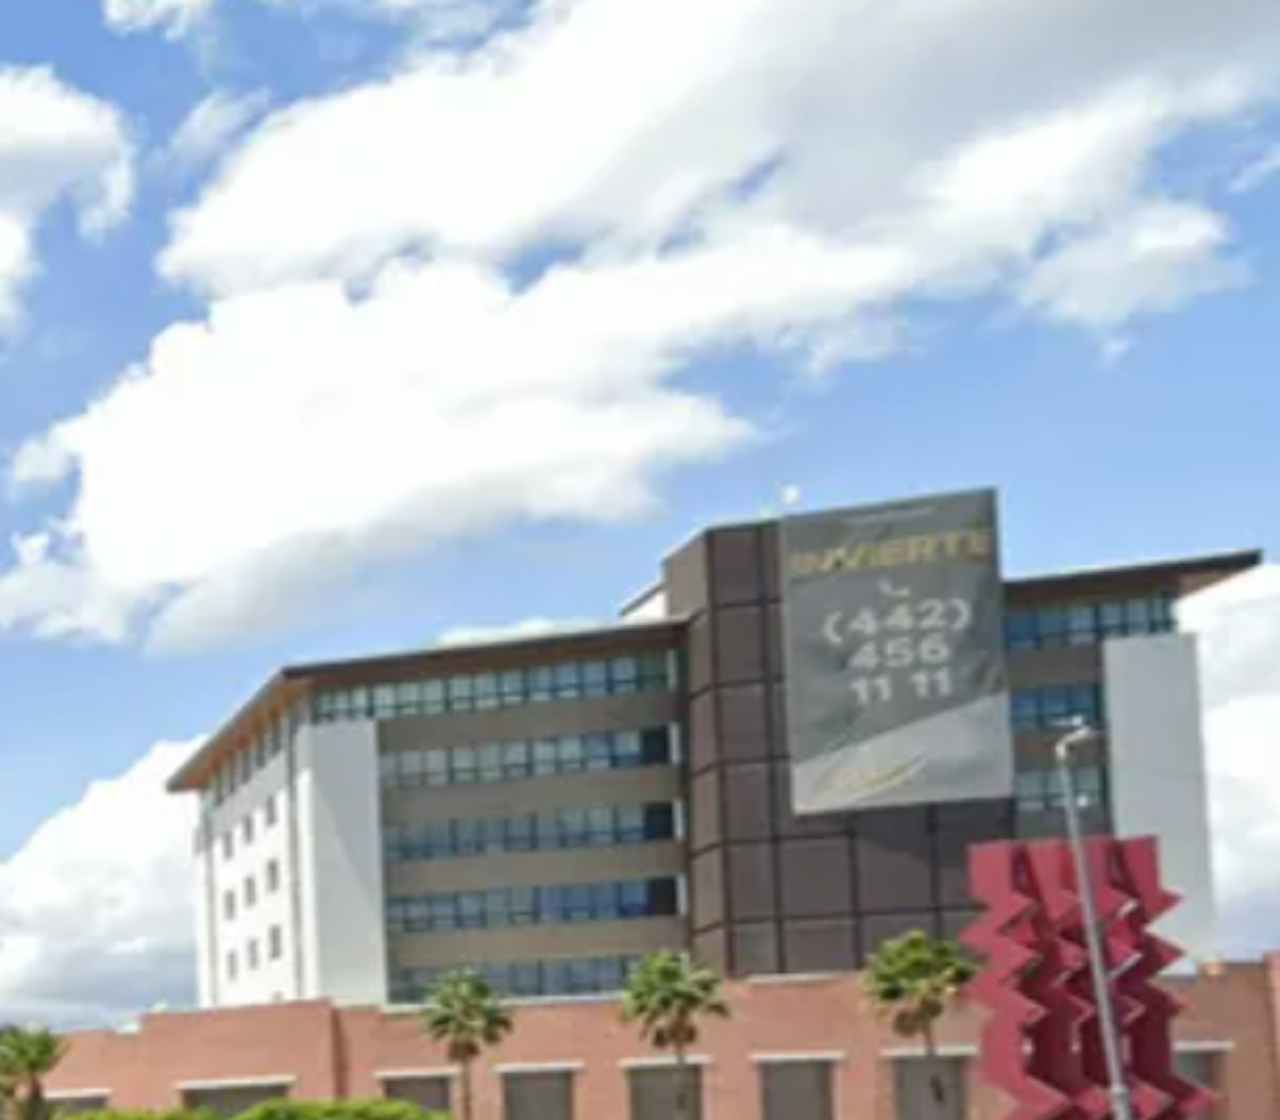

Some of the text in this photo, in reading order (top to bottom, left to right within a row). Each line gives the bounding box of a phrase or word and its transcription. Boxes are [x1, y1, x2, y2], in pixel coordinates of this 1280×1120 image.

[822, 597, 971, 645] (442)
[849, 632, 950, 669] 456
[850, 667, 952, 704] 11 11
